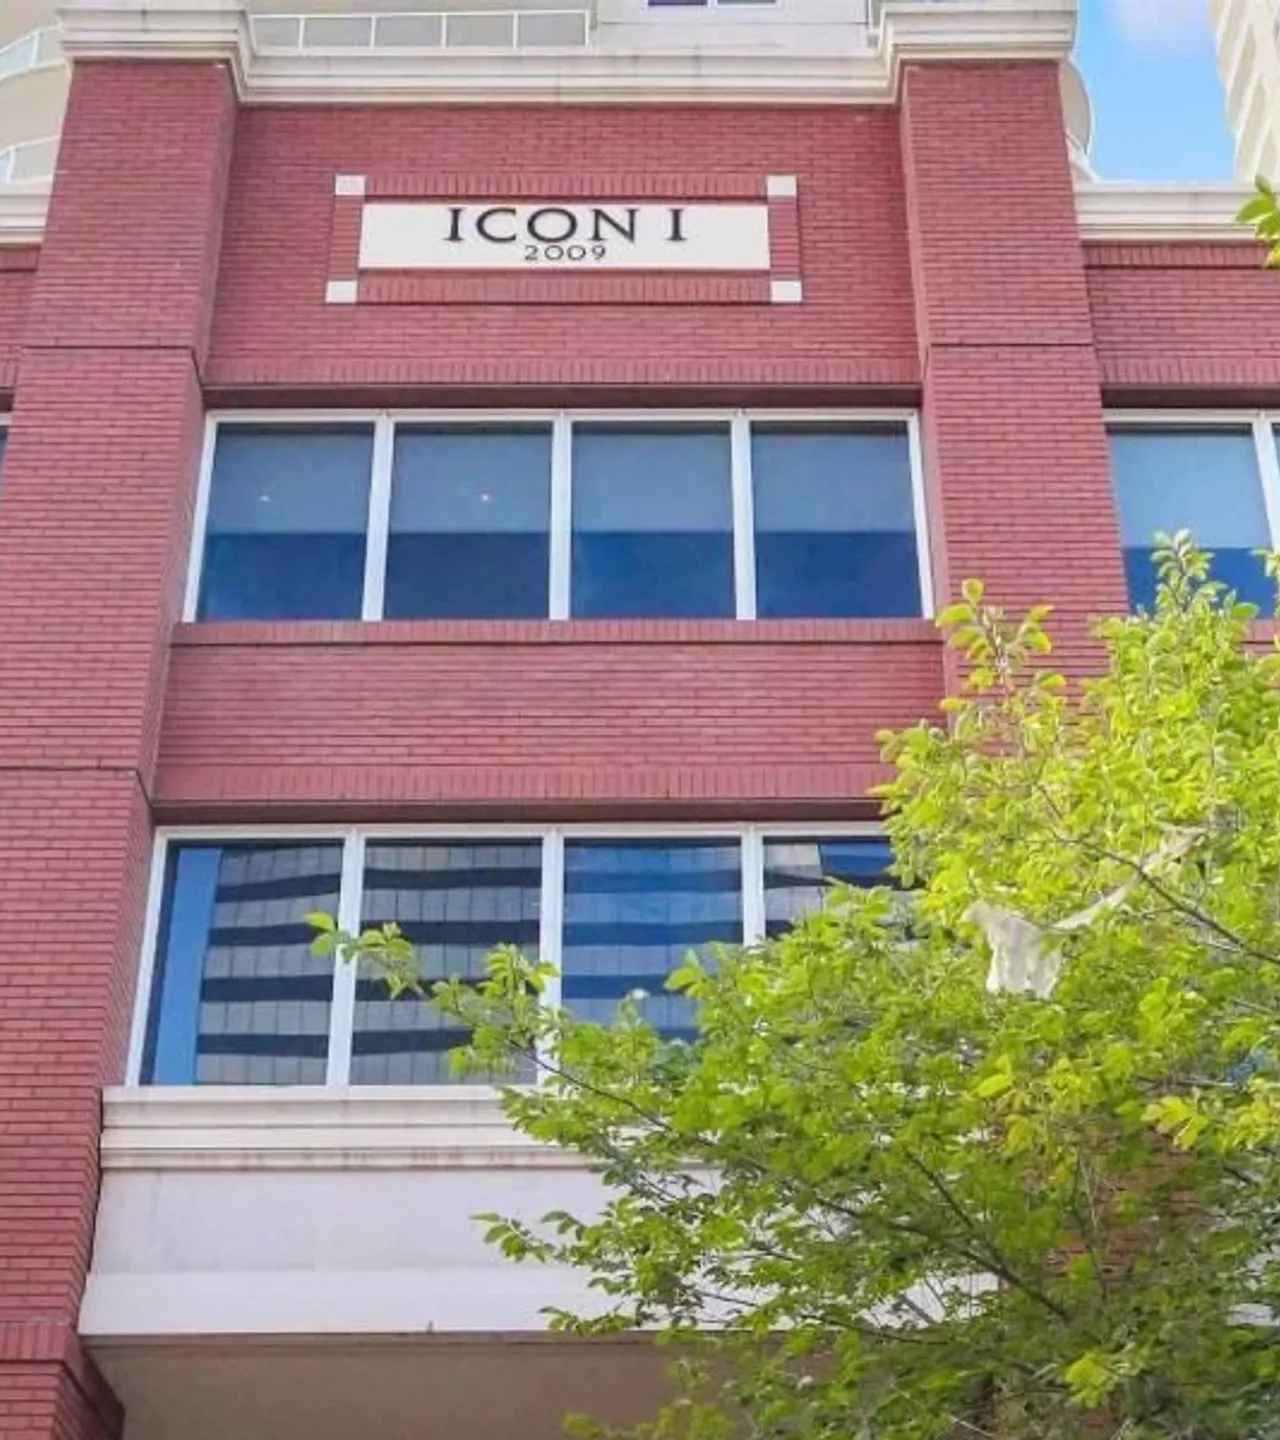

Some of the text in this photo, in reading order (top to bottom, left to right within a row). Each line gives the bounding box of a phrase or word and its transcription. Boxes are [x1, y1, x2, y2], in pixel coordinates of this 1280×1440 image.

[443, 207, 688, 242] ICON I
[524, 245, 607, 261] 2009
